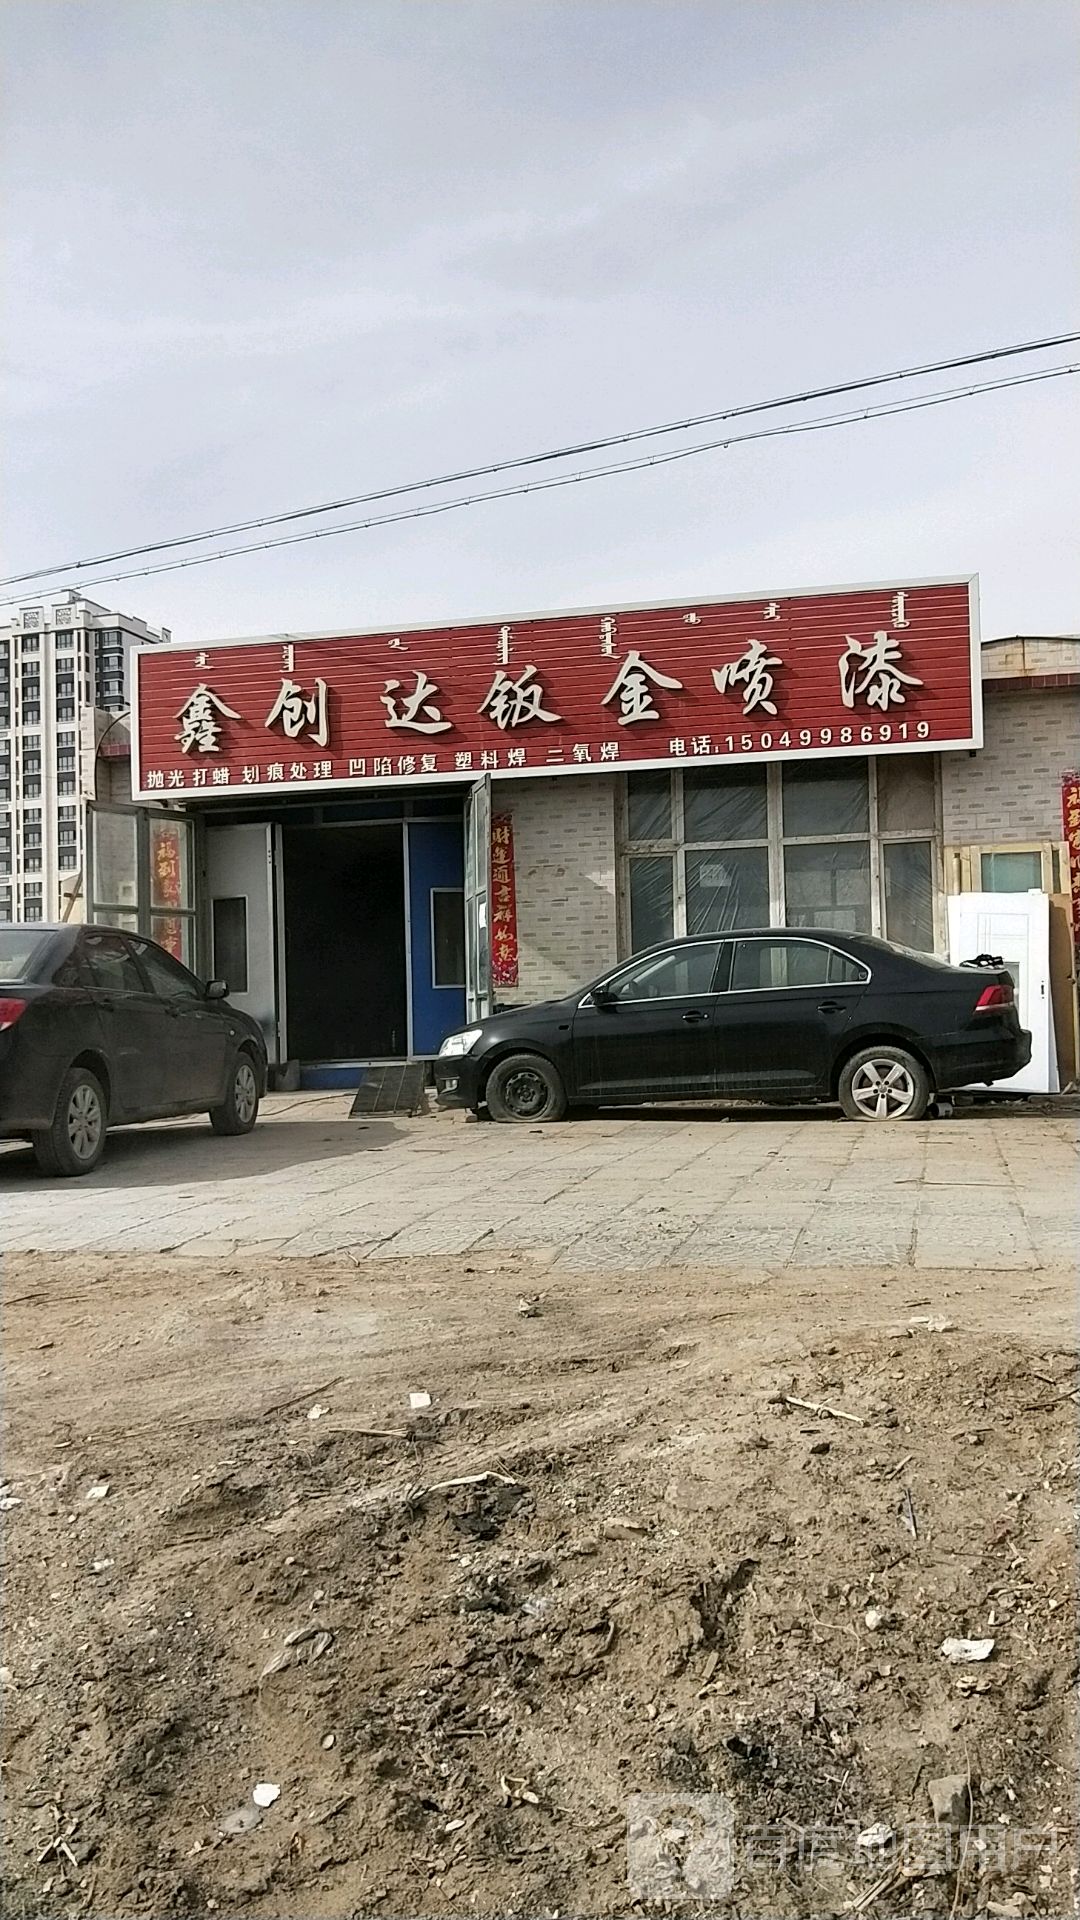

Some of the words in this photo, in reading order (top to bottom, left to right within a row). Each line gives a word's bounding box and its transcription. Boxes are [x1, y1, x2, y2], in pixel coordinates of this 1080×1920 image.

[174, 630, 924, 754] 鑫创达钣金喷漆
[146, 769, 185, 788] 抛光
[193, 768, 230, 787] 打蜡
[242, 761, 333, 783] 划痕处理
[348, 753, 438, 776] 凹陷修复
[454, 747, 527, 771] 塑料焊
[546, 742, 620, 763] 二氧焊
